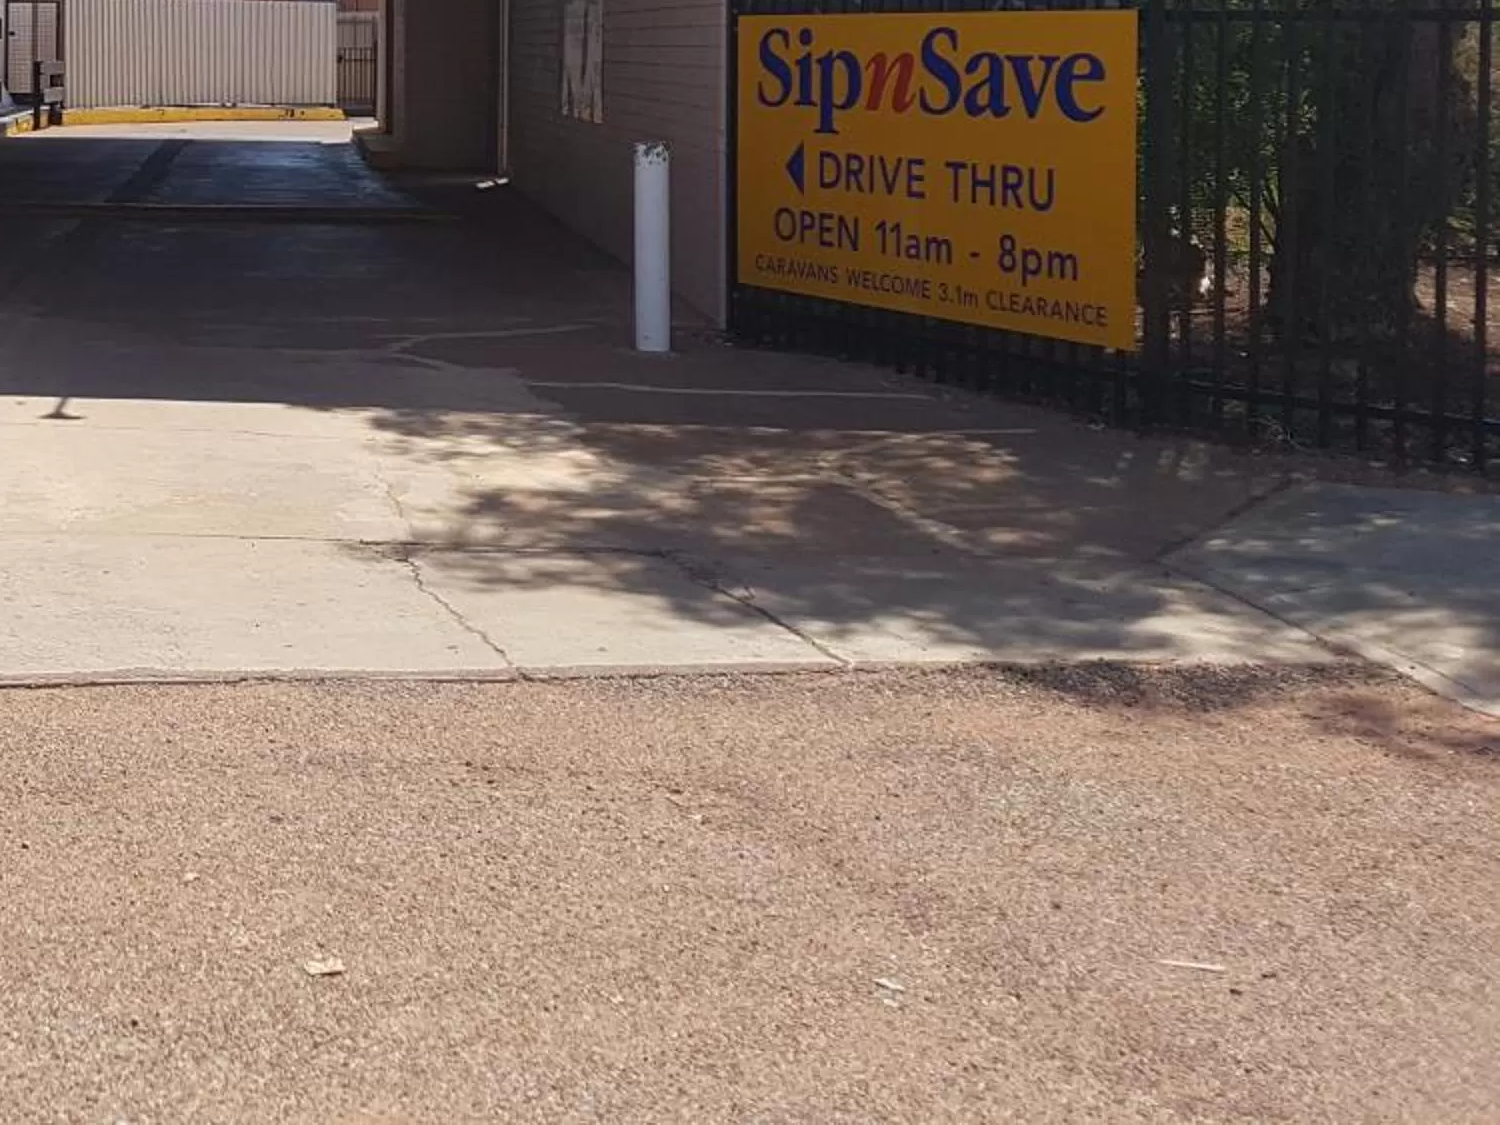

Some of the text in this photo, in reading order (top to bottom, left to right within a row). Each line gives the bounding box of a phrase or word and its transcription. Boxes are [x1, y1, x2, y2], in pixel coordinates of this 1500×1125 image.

[819, 150, 1056, 212] DRIVE THRU
[774, 207, 859, 252] OPEN
[875, 220, 952, 265] 11am
[998, 234, 1079, 287] 8pm
[755, 253, 1109, 328] CARAVANS WELCOME 3.1m CLEARANCE
